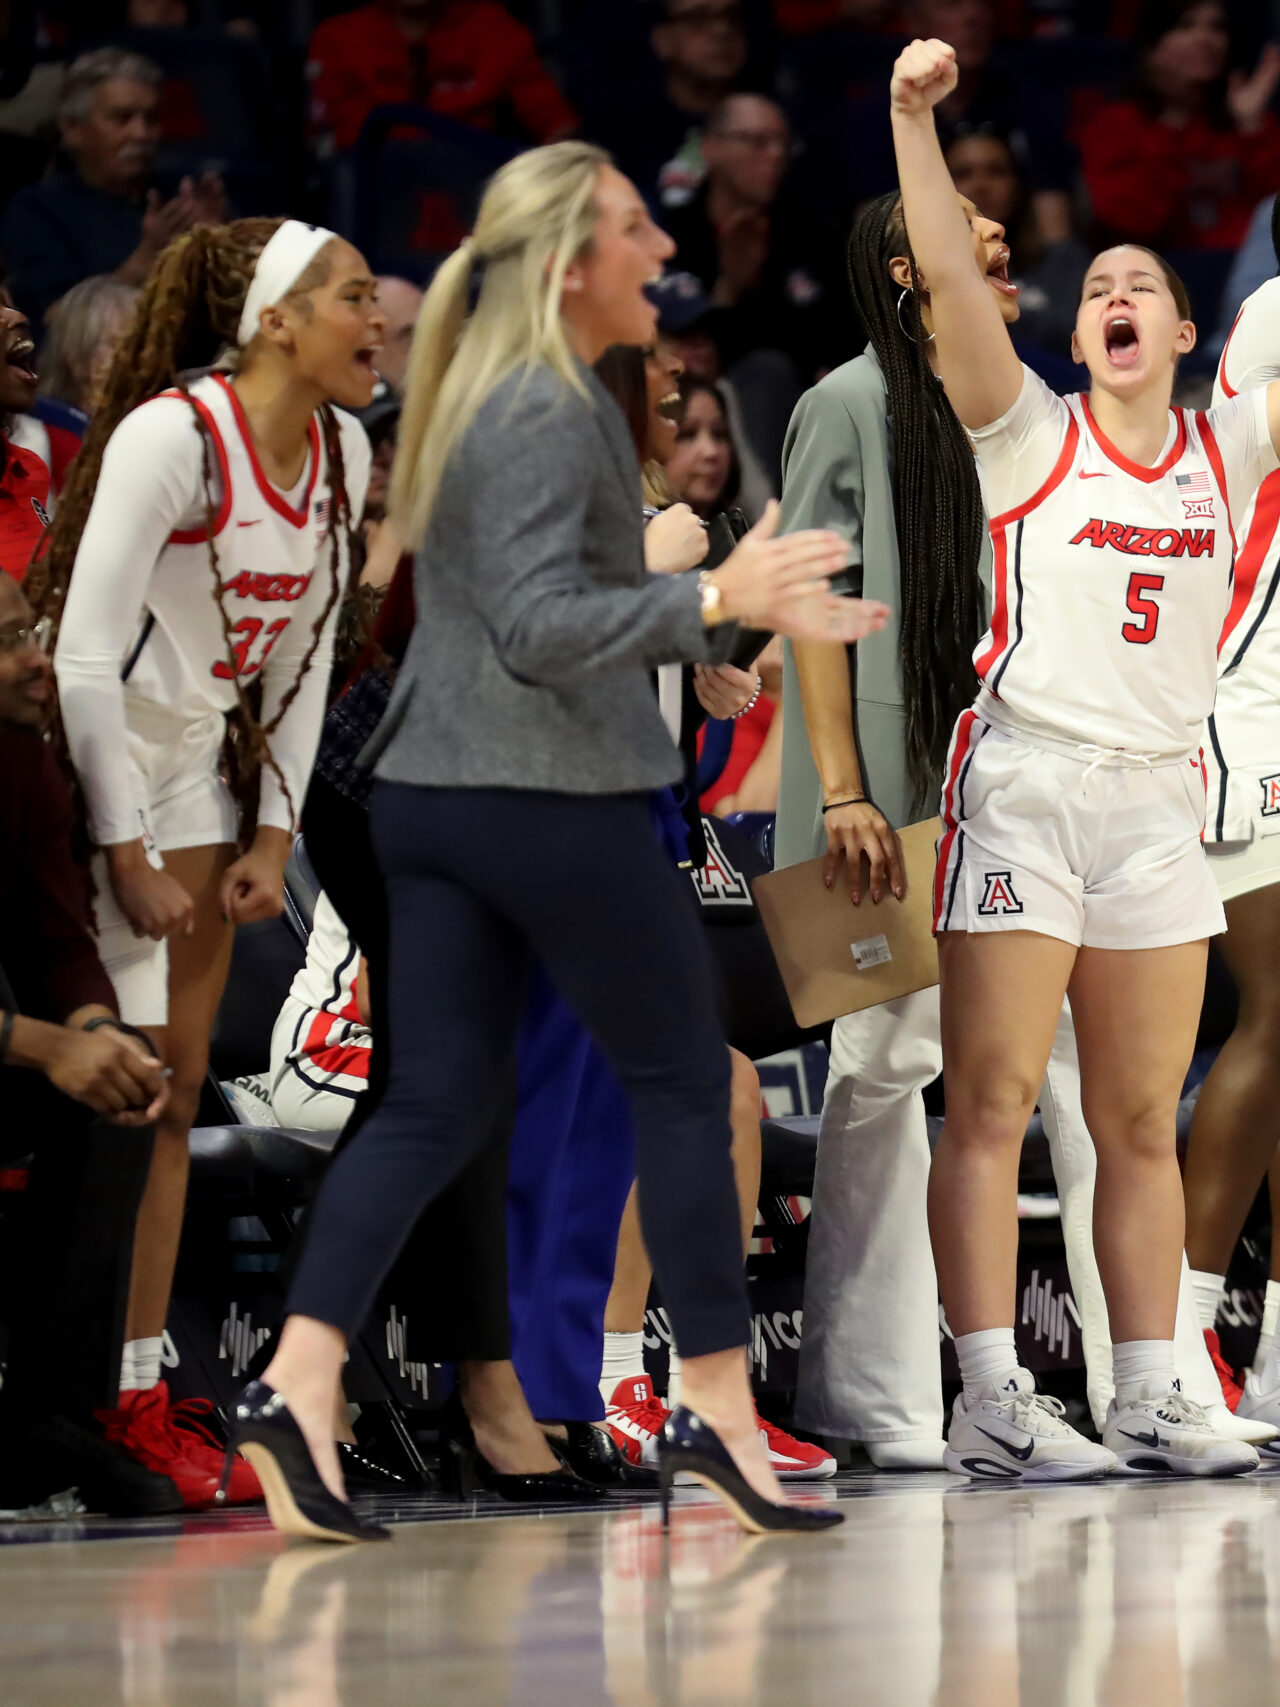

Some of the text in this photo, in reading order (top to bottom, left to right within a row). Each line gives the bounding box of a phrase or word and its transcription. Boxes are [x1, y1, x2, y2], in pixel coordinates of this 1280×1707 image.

[1068, 518, 1215, 558] ARIZONA
[222, 569, 315, 602] ARIZO
[1122, 572, 1165, 644] 5
[211, 616, 290, 680] 33
[978, 871, 1024, 915] A
[633, 1383, 648, 1402] S
